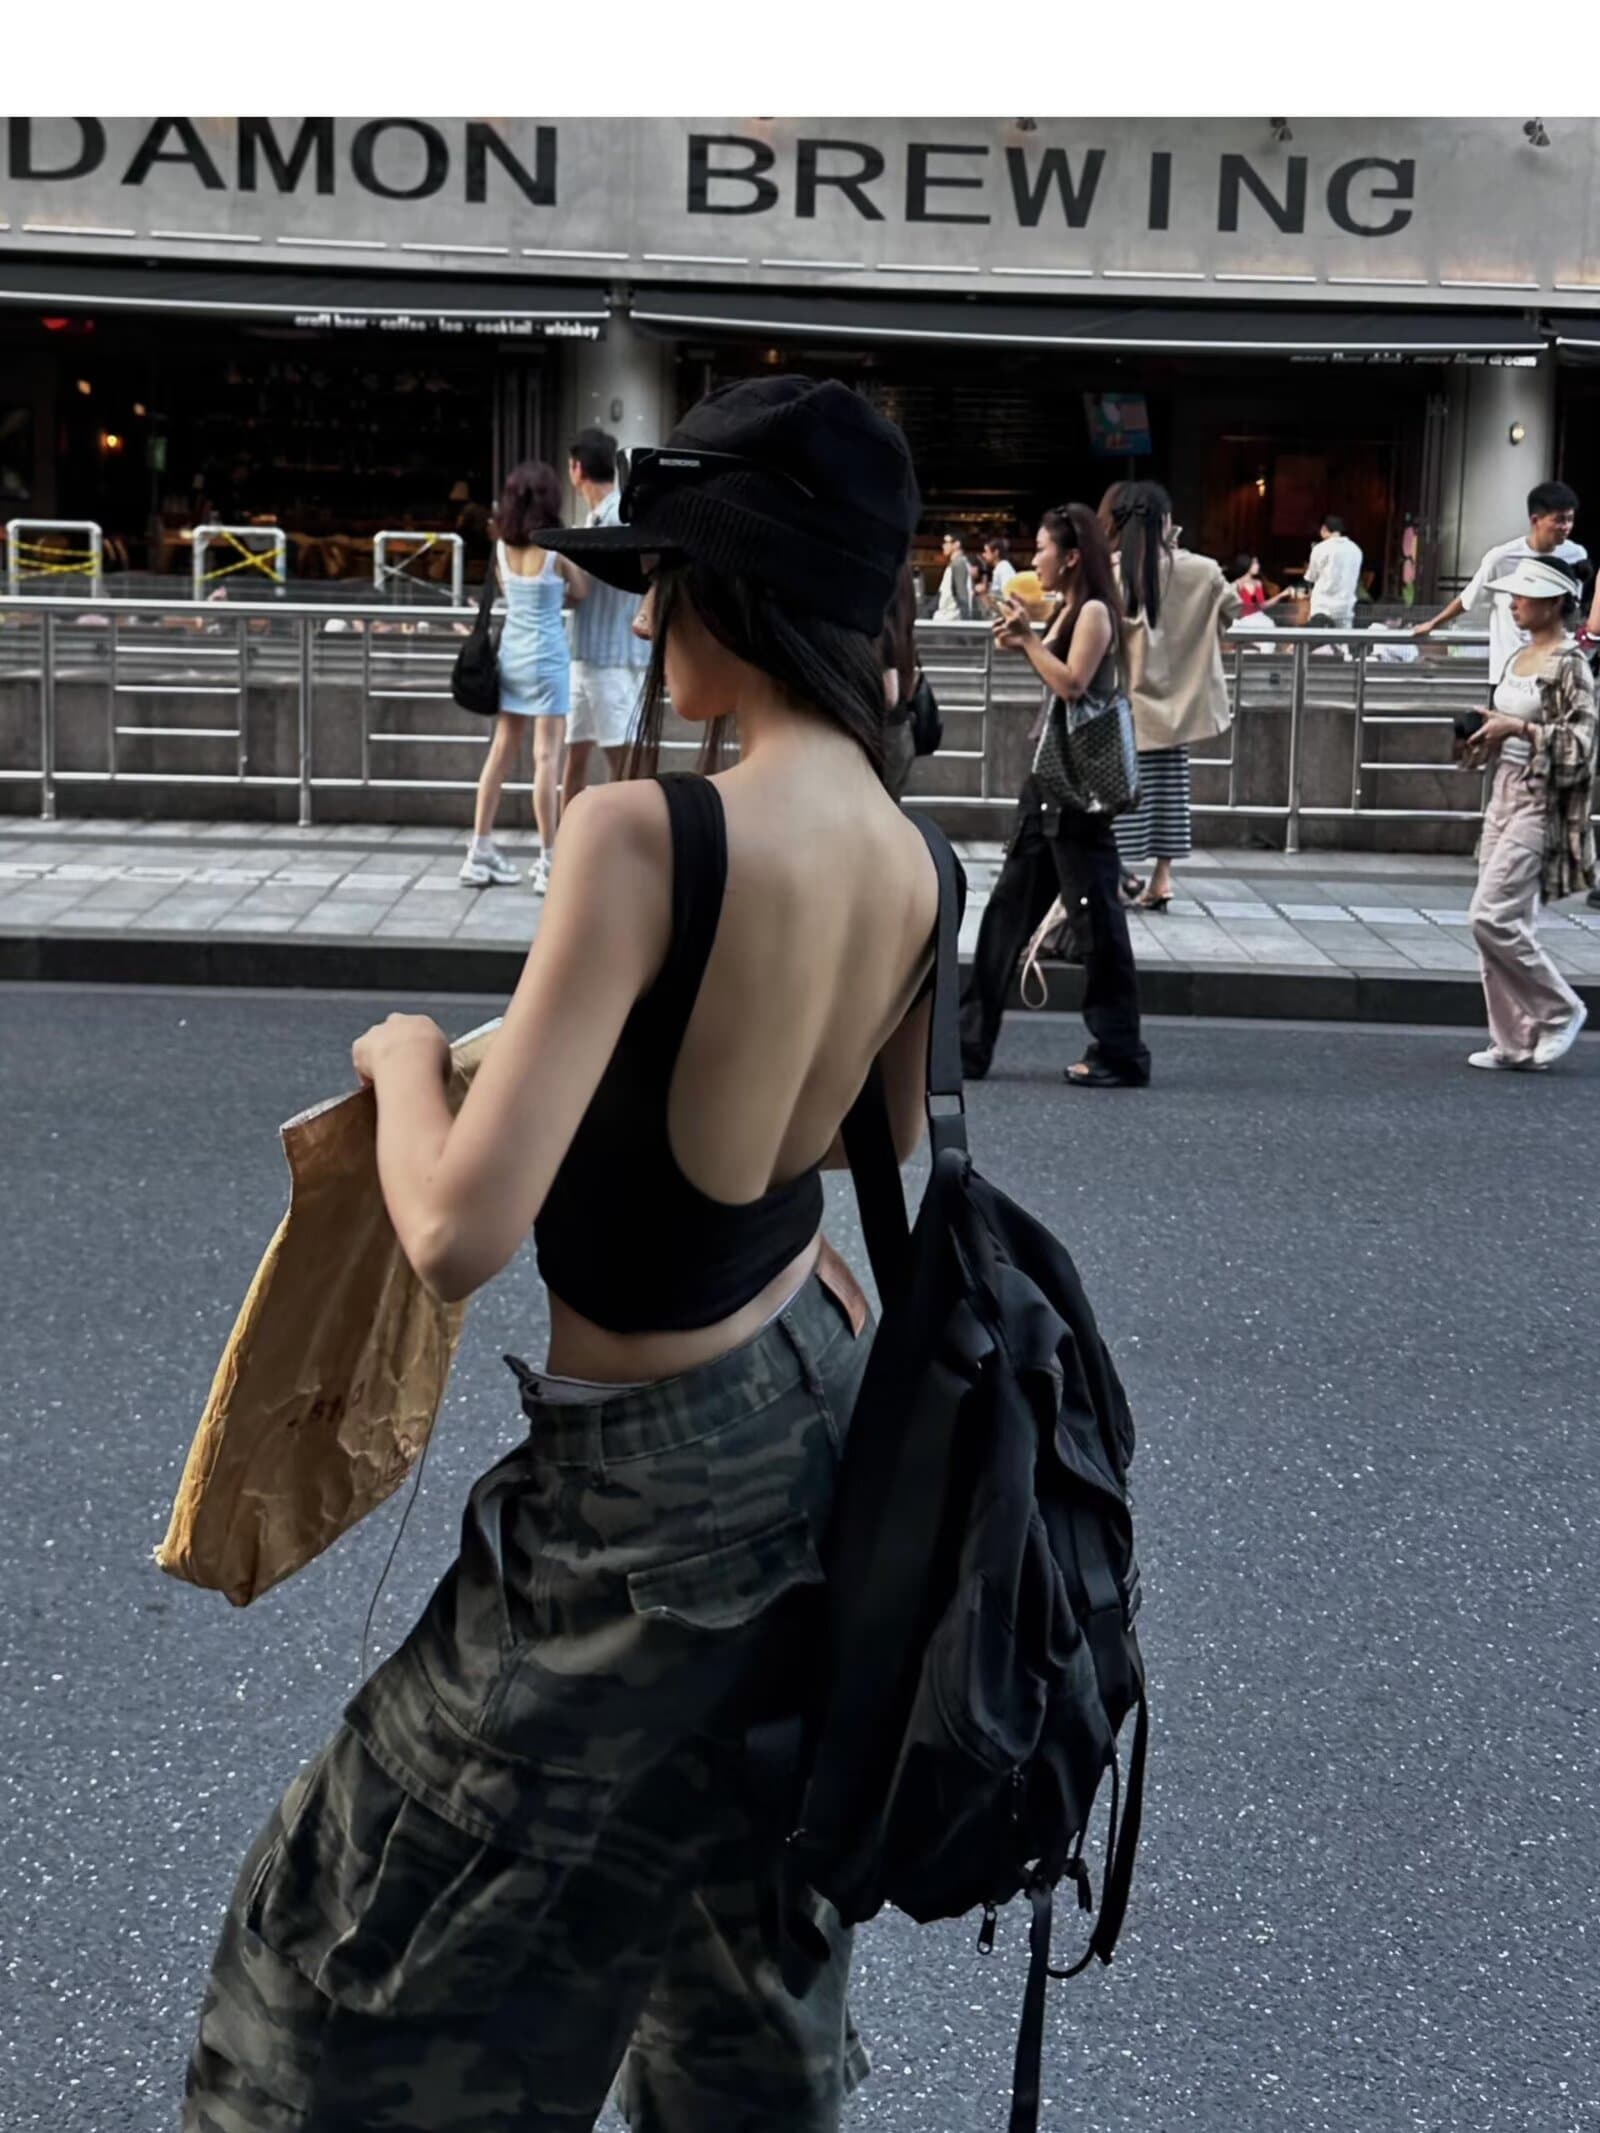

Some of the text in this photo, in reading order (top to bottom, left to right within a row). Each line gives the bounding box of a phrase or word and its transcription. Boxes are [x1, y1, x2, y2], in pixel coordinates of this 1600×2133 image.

[8, 117, 558, 207] DAMON
[380, 315, 426, 331] coffee
[475, 318, 533, 334] cocktail
[544, 319, 600, 340] whiskey
